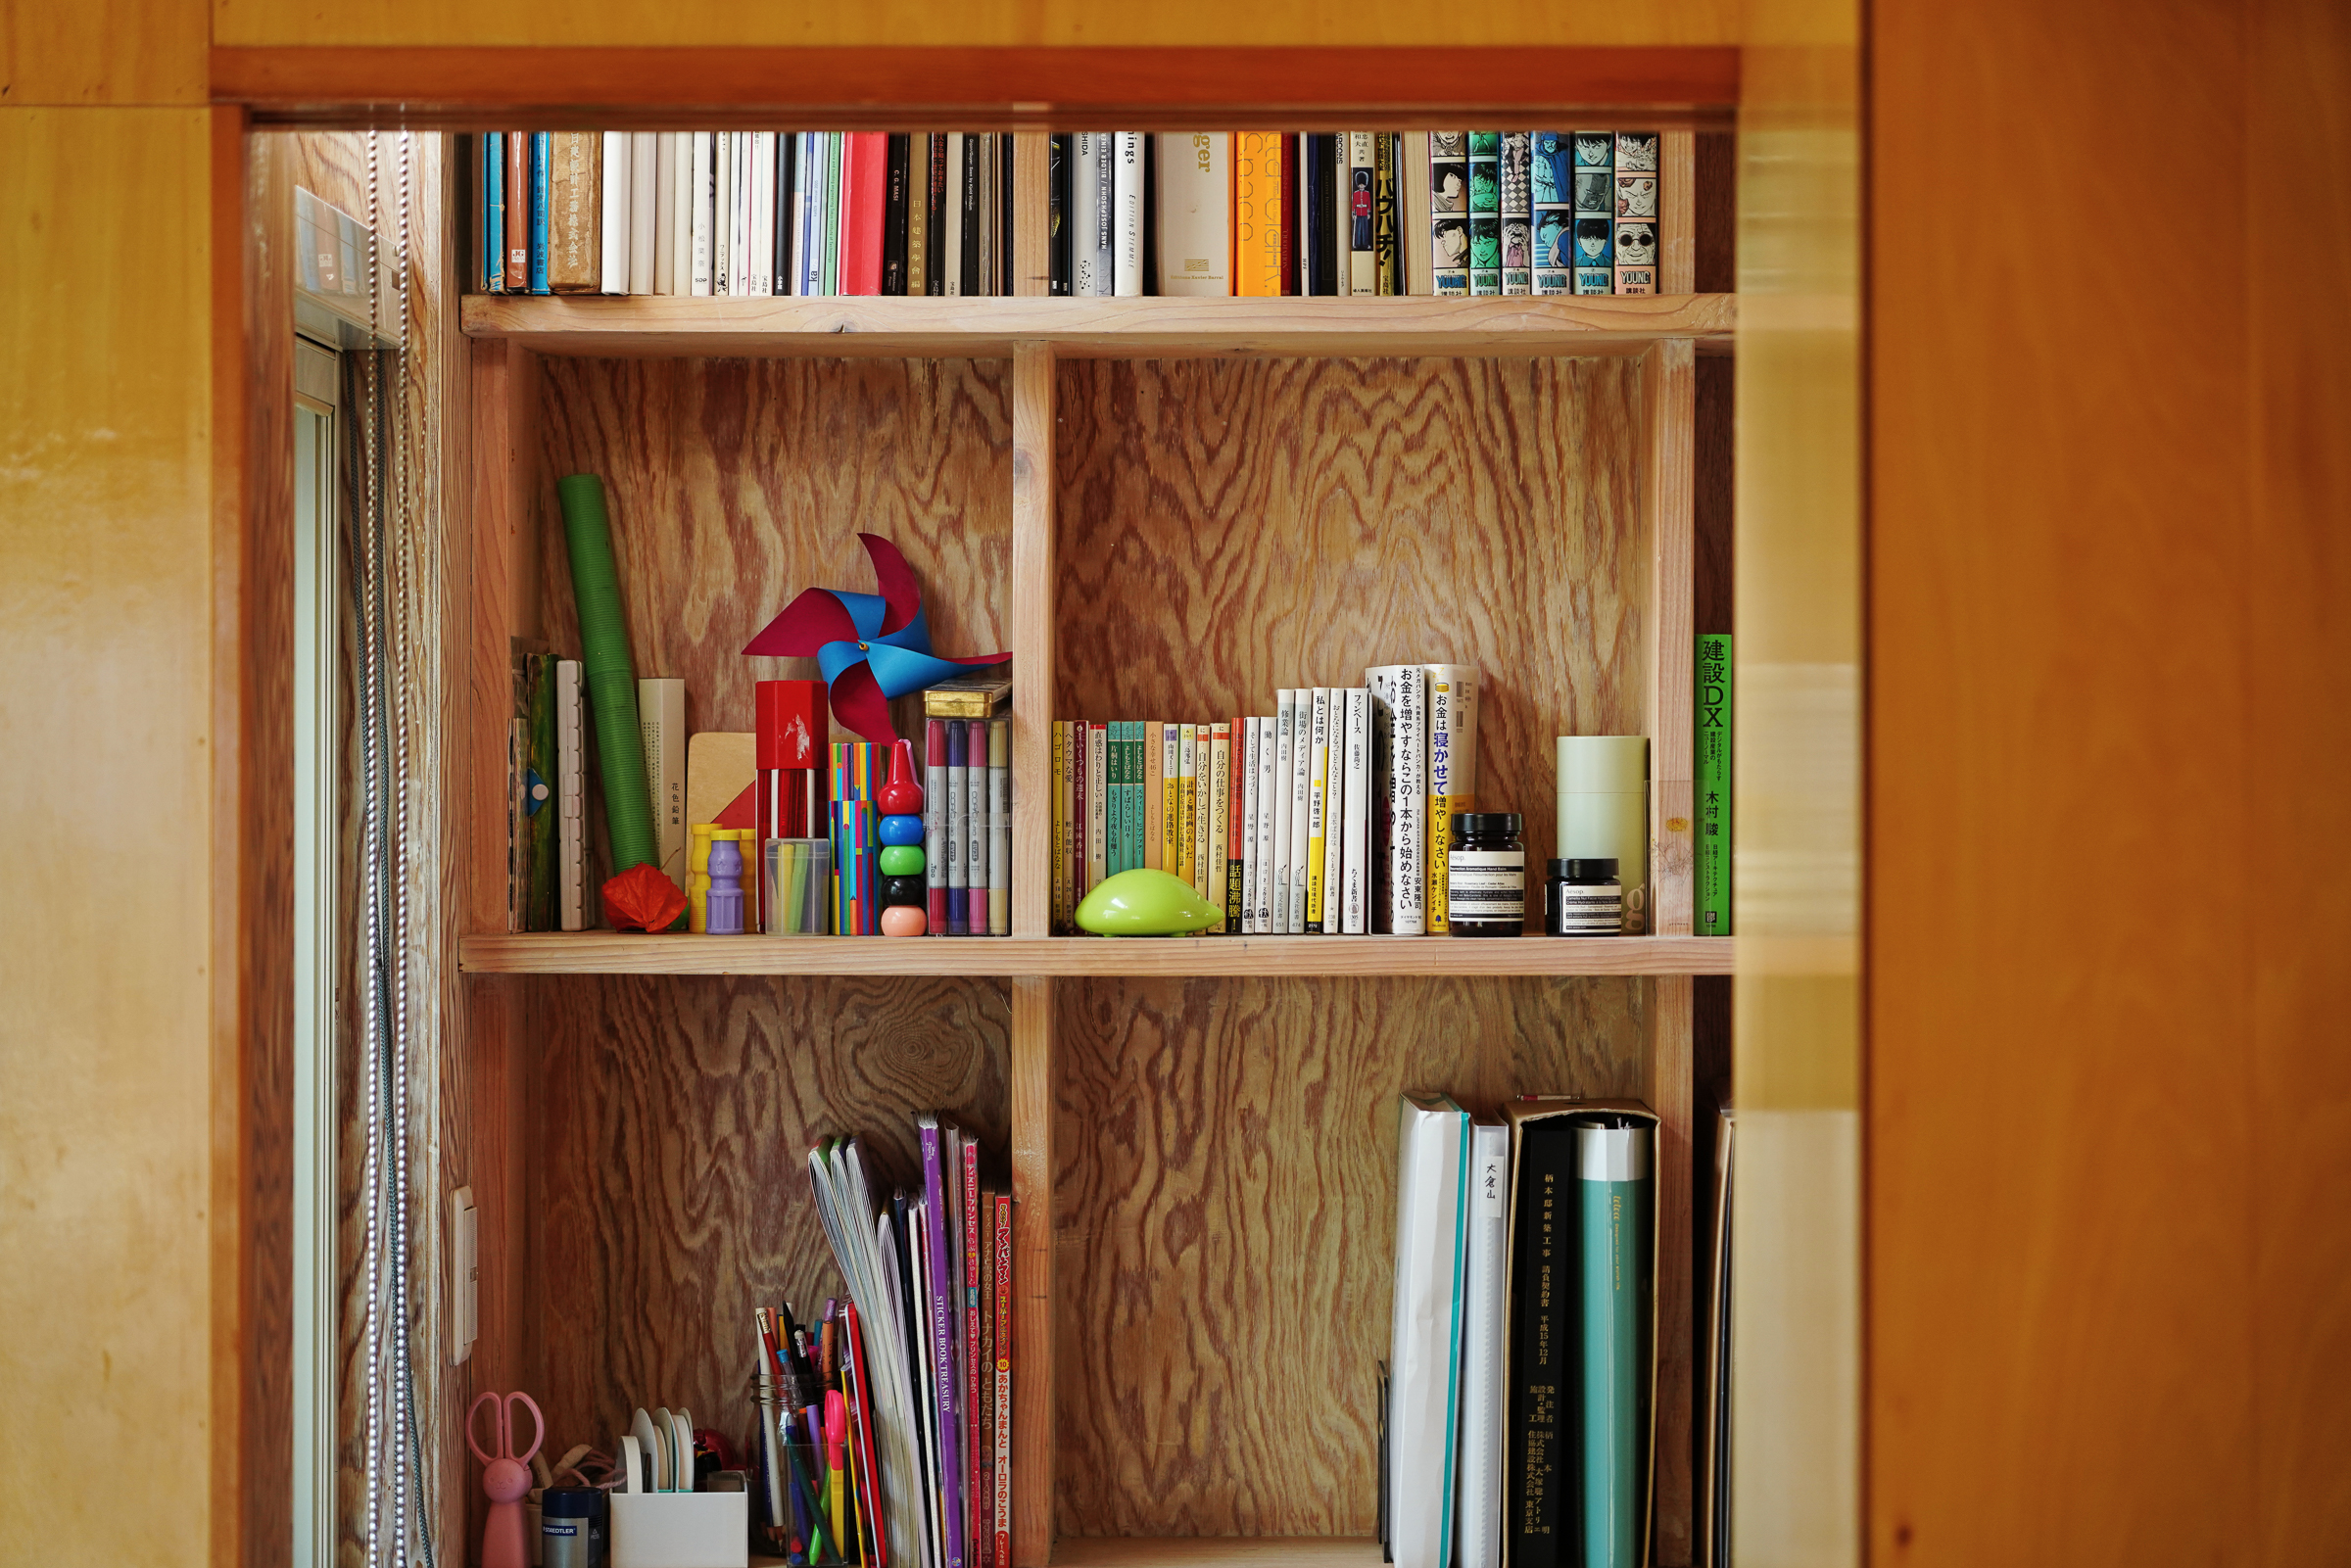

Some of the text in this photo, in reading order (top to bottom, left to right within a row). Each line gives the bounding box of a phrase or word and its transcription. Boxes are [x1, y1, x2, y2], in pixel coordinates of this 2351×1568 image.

[1193, 131, 1211, 173] ger
[536, 243, 545, 274] 岩波書店
[911, 200, 922, 289] 日本建築學會編
[1436, 275, 1467, 289] YOUNG
[1473, 273, 1499, 287] YOUNG
[1504, 272, 1528, 285] YOUNG
[1537, 274, 1567, 289] YOUNG
[1578, 272, 1608, 287] YOUNG
[1620, 270, 1651, 285] YOUNG
[1702, 640, 1726, 728] 建設DX
[1263, 731, 1272, 774] 働く男
[1280, 709, 1289, 736] 修業論
[1296, 710, 1308, 777] 街場のメディア論
[1331, 704, 1341, 800] おとなになるってどんなこと?
[1065, 733, 1074, 784] ヘタウマな愛
[1094, 731, 1103, 798] 直感はわりと正しい
[1312, 695, 1325, 829] 私とは何か 平野啓一郎
[1400, 668, 1413, 910] お金を増やすならこの1本から始めなさい
[1433, 693, 1450, 870] お金は寝かせて増やしなさい
[1185, 780, 1194, 859] 計画と無計画のあいだ
[1196, 751, 1208, 883] 自分をいかして生きる 西村佳哲
[1216, 749, 1225, 833] 自分の仕事をつくる
[1705, 790, 1719, 836] 木村駿
[1228, 864, 1241, 930] 話題沸騰!
[1414, 877, 1422, 910] 安東隆司
[966, 1164, 976, 1234] ディズニープリンセス
[1485, 1163, 1497, 1200] 大倉山
[983, 1241, 993, 1300] アナと雪の女王
[997, 1227, 1010, 1286] アンパンマン
[1539, 1173, 1554, 1365] 柄本邸新築工事 請負契約書 平成15年12月
[936, 1295, 950, 1413] STICKER BOOK TREASURY
[982, 1310, 993, 1373] トナカイの
[982, 1377, 993, 1430] ともだち
[1535, 1385, 1547, 1463] 設計・監理 株式会社
[997, 1373, 1008, 1528] あかちゃんまんと オーロラのこうま
[1523, 1499, 1535, 1534] 東京支店
